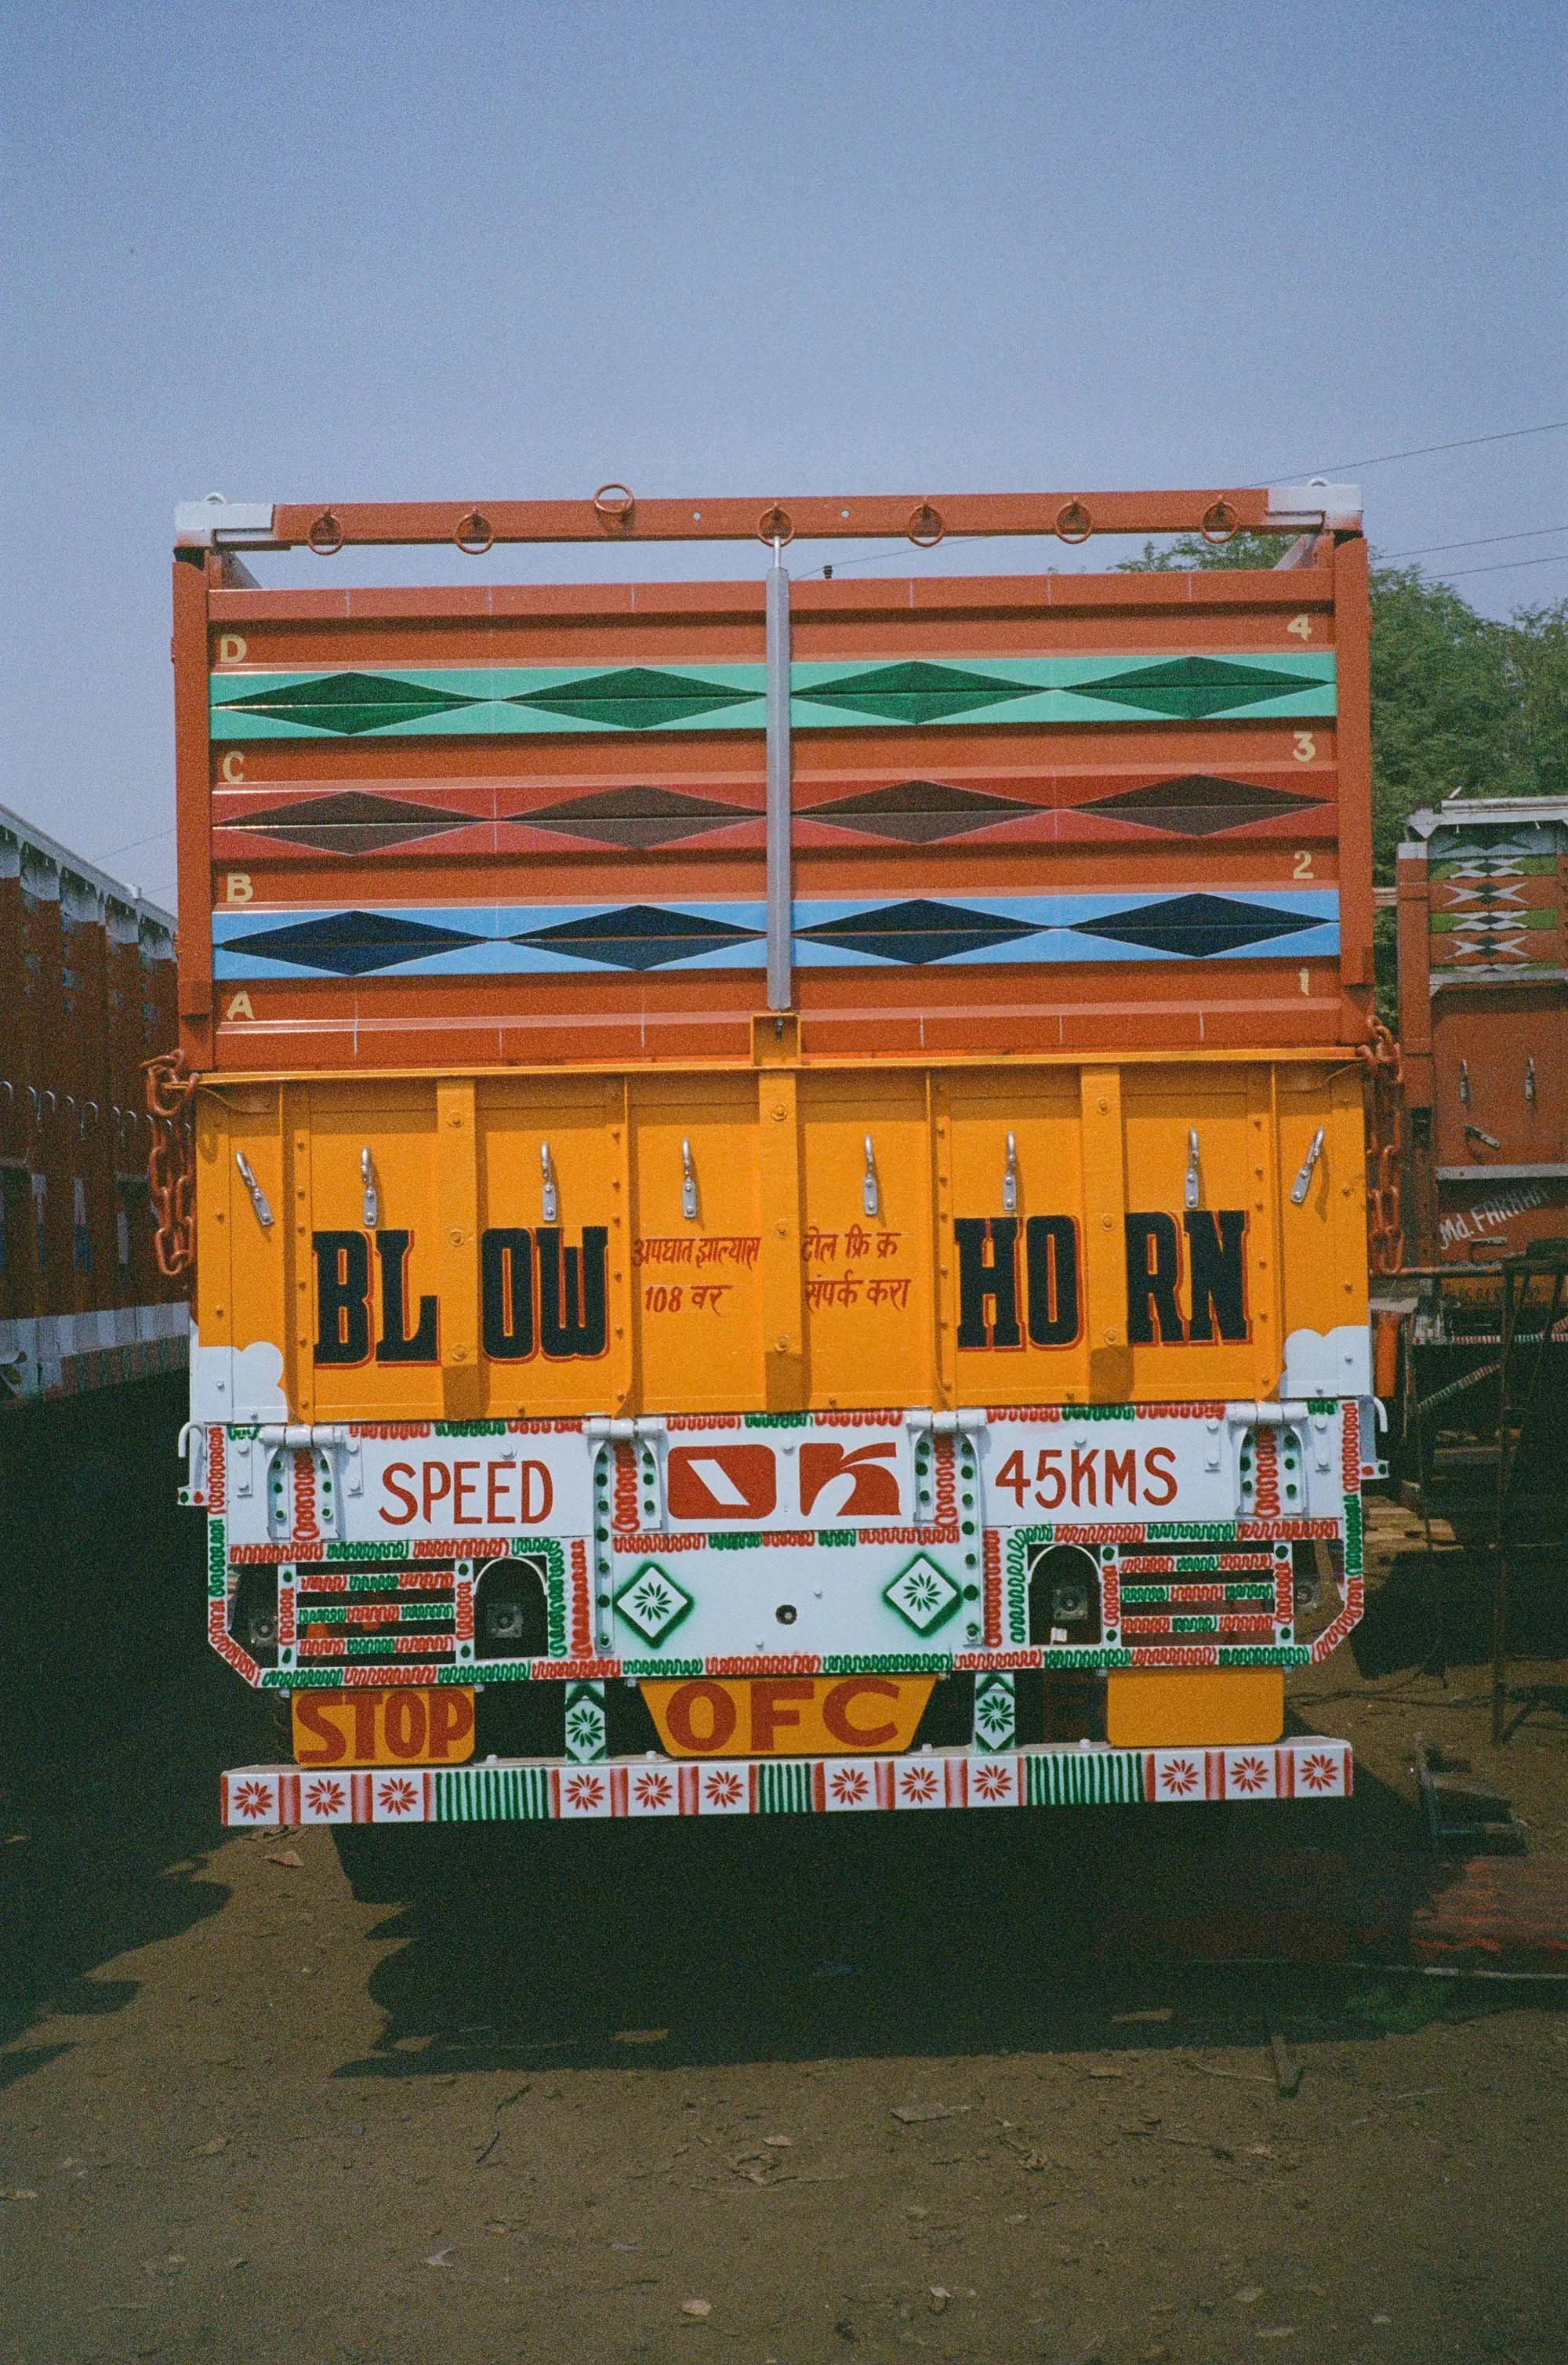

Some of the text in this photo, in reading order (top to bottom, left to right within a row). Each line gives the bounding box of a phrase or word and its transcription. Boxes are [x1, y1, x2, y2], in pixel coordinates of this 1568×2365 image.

[1287, 614, 1312, 641] 4
[220, 634, 248, 665] D
[1291, 731, 1316, 762] 3
[222, 750, 245, 785] C
[1292, 850, 1314, 880] 2
[226, 872, 254, 903] B
[1298, 968, 1309, 996] 1
[225, 990, 256, 1020] A
[644, 1286, 684, 1313] 108
[690, 1284, 734, 1318] वर
[869, 1278, 912, 1312] करा
[378, 1446, 1178, 1525] SPEED 45KMS
[296, 1687, 473, 1764] STOP
[666, 1677, 900, 1752] OFC
